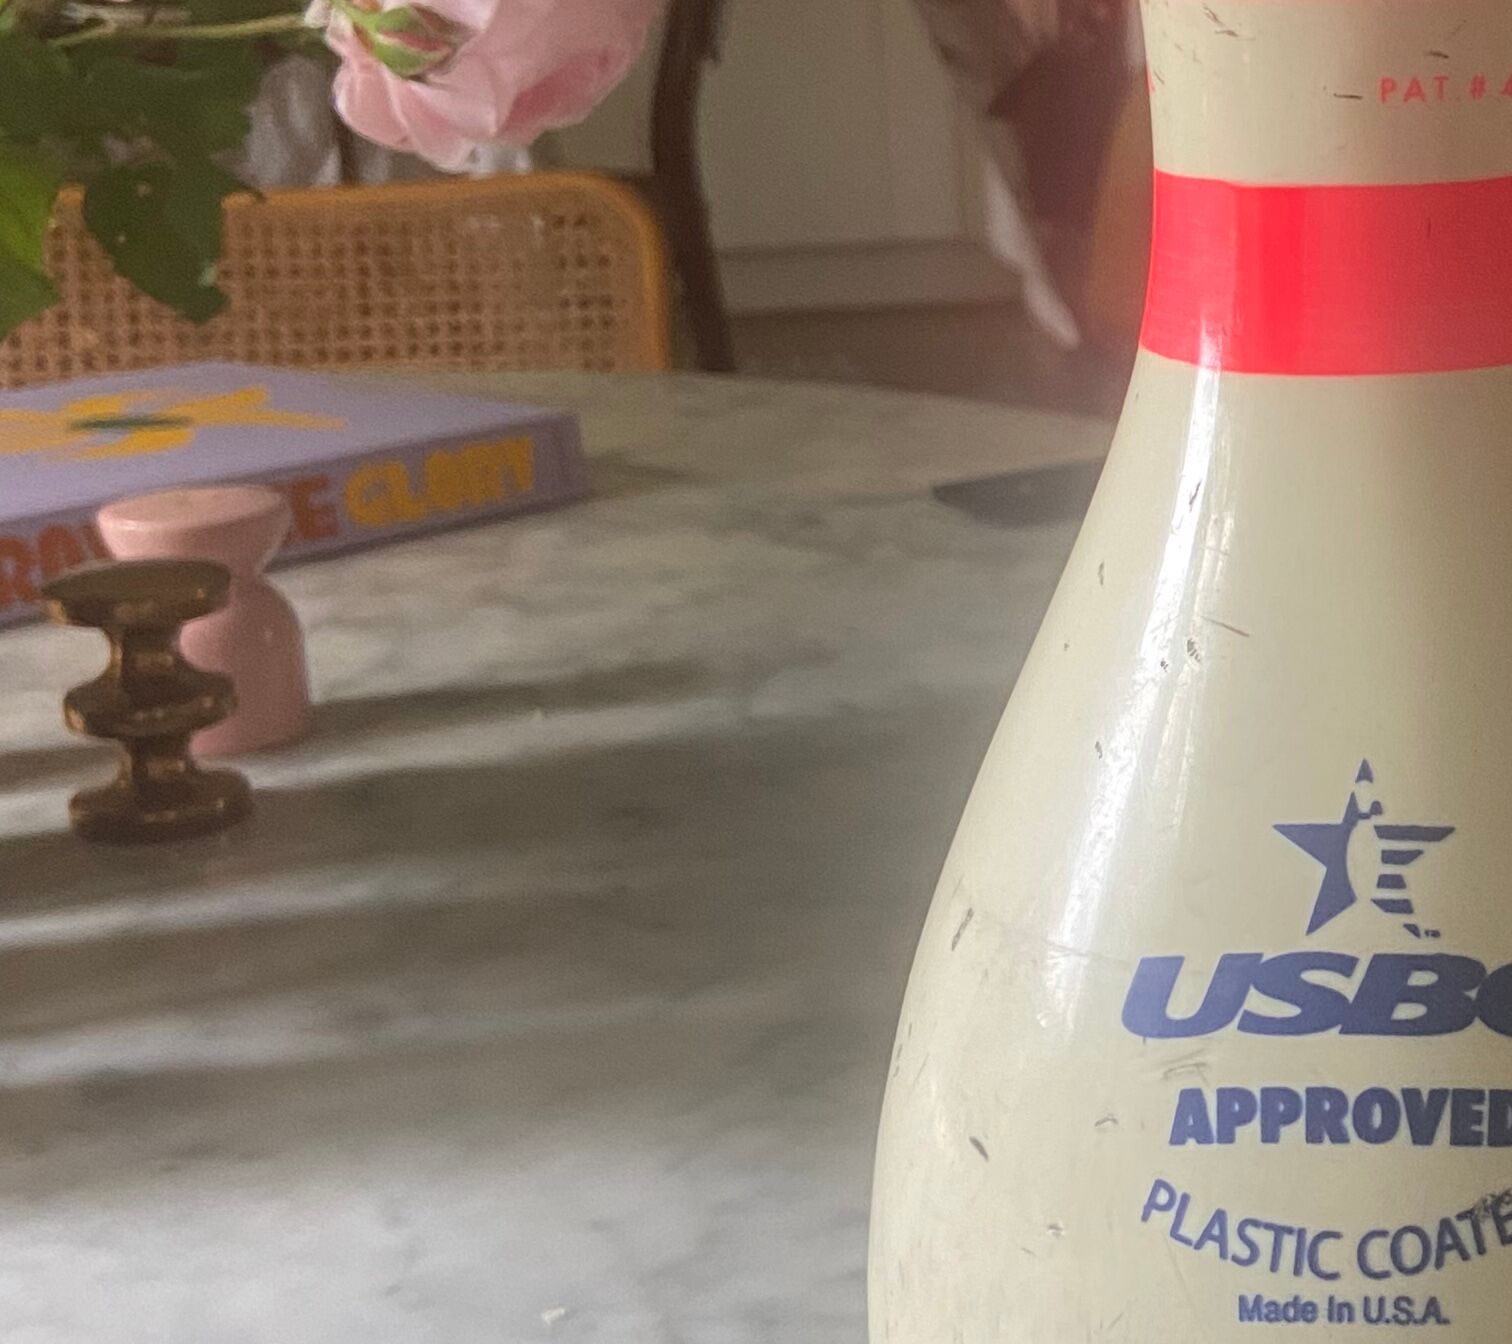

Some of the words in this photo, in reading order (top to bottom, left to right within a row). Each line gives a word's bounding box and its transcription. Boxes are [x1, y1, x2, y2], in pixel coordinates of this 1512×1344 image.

[1140, 1177, 1344, 1281] PLASTIC
[1237, 1293, 1319, 1324] Made
[1326, 1294, 1356, 1324] In
[1362, 1294, 1452, 1326] U.S.A.
